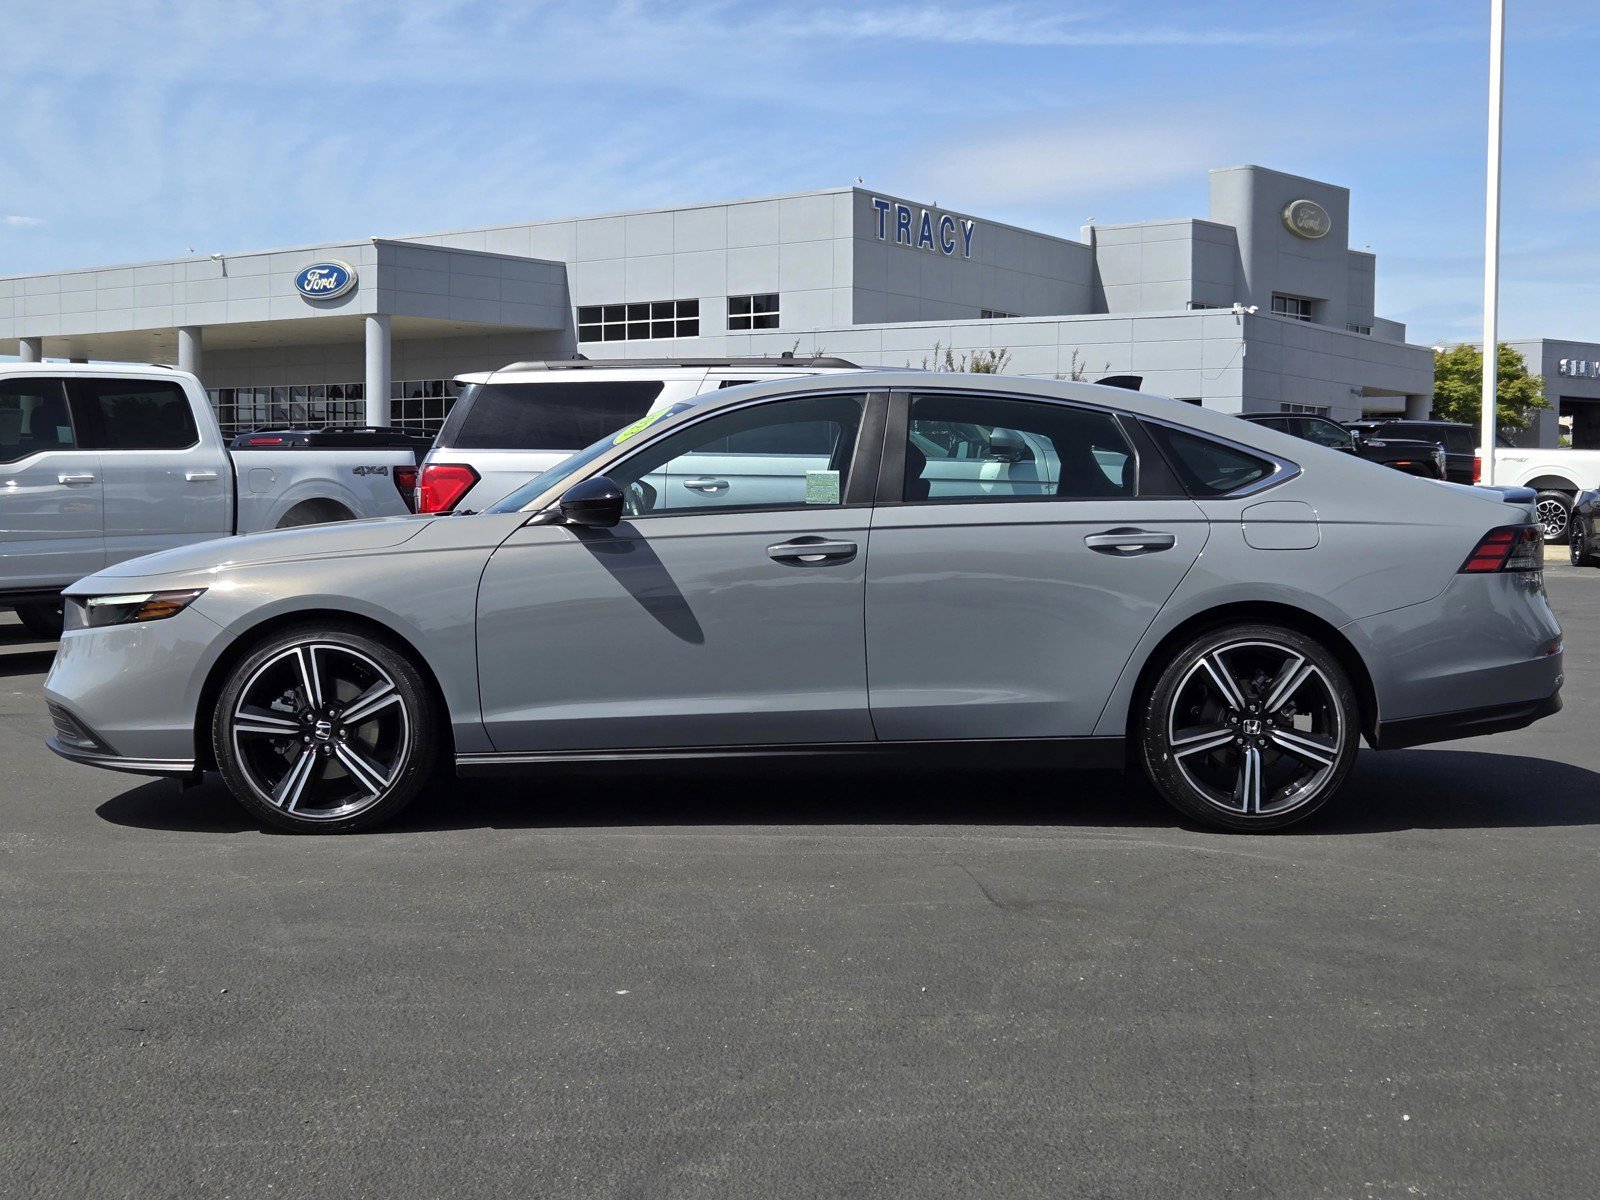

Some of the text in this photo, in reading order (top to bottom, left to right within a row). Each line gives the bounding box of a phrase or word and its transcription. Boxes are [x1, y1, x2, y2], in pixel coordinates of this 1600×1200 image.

[872, 197, 975, 259] TRACY
[1297, 207, 1321, 231] Ford
[304, 268, 338, 291] Ford
